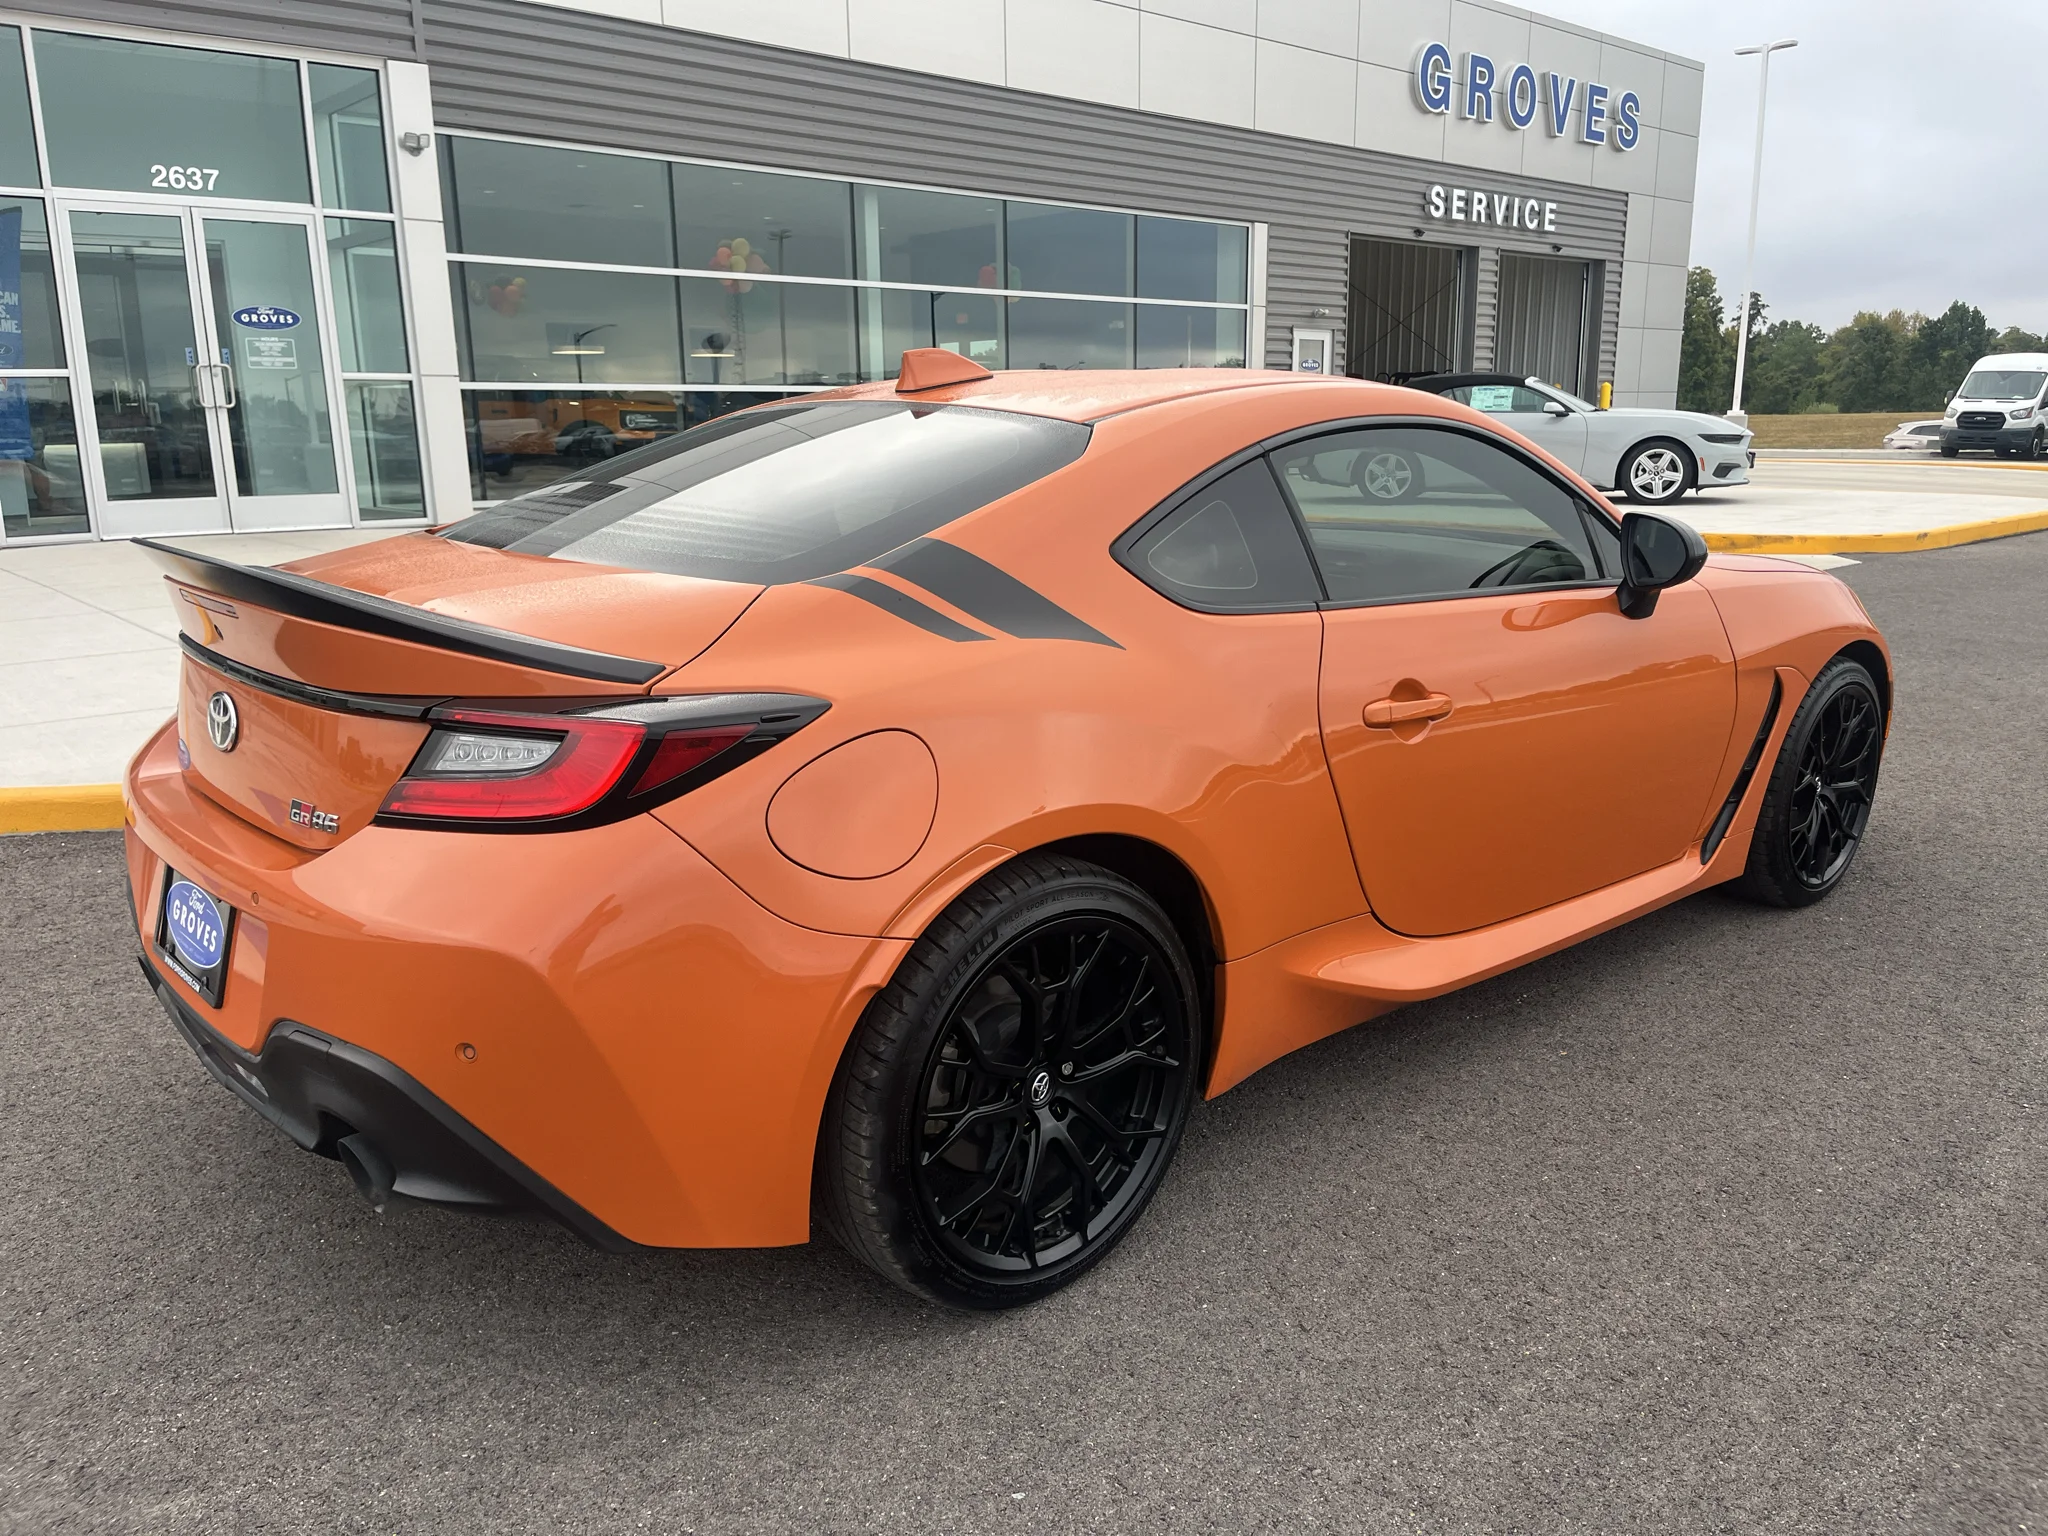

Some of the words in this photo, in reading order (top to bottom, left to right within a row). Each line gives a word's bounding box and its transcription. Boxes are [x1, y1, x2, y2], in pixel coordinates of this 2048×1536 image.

[1413, 41, 1641, 151] GROVES
[150, 164, 220, 191] 2637
[1426, 184, 1557, 232] SERVICE
[241, 313, 294, 324] GROVES
[188, 888, 206, 915] Ford
[1004, 908, 1024, 926] PILOT
[1026, 897, 1049, 913] SPORT
[173, 899, 218, 953] GROVES
[922, 925, 999, 1025] MICHELIN
